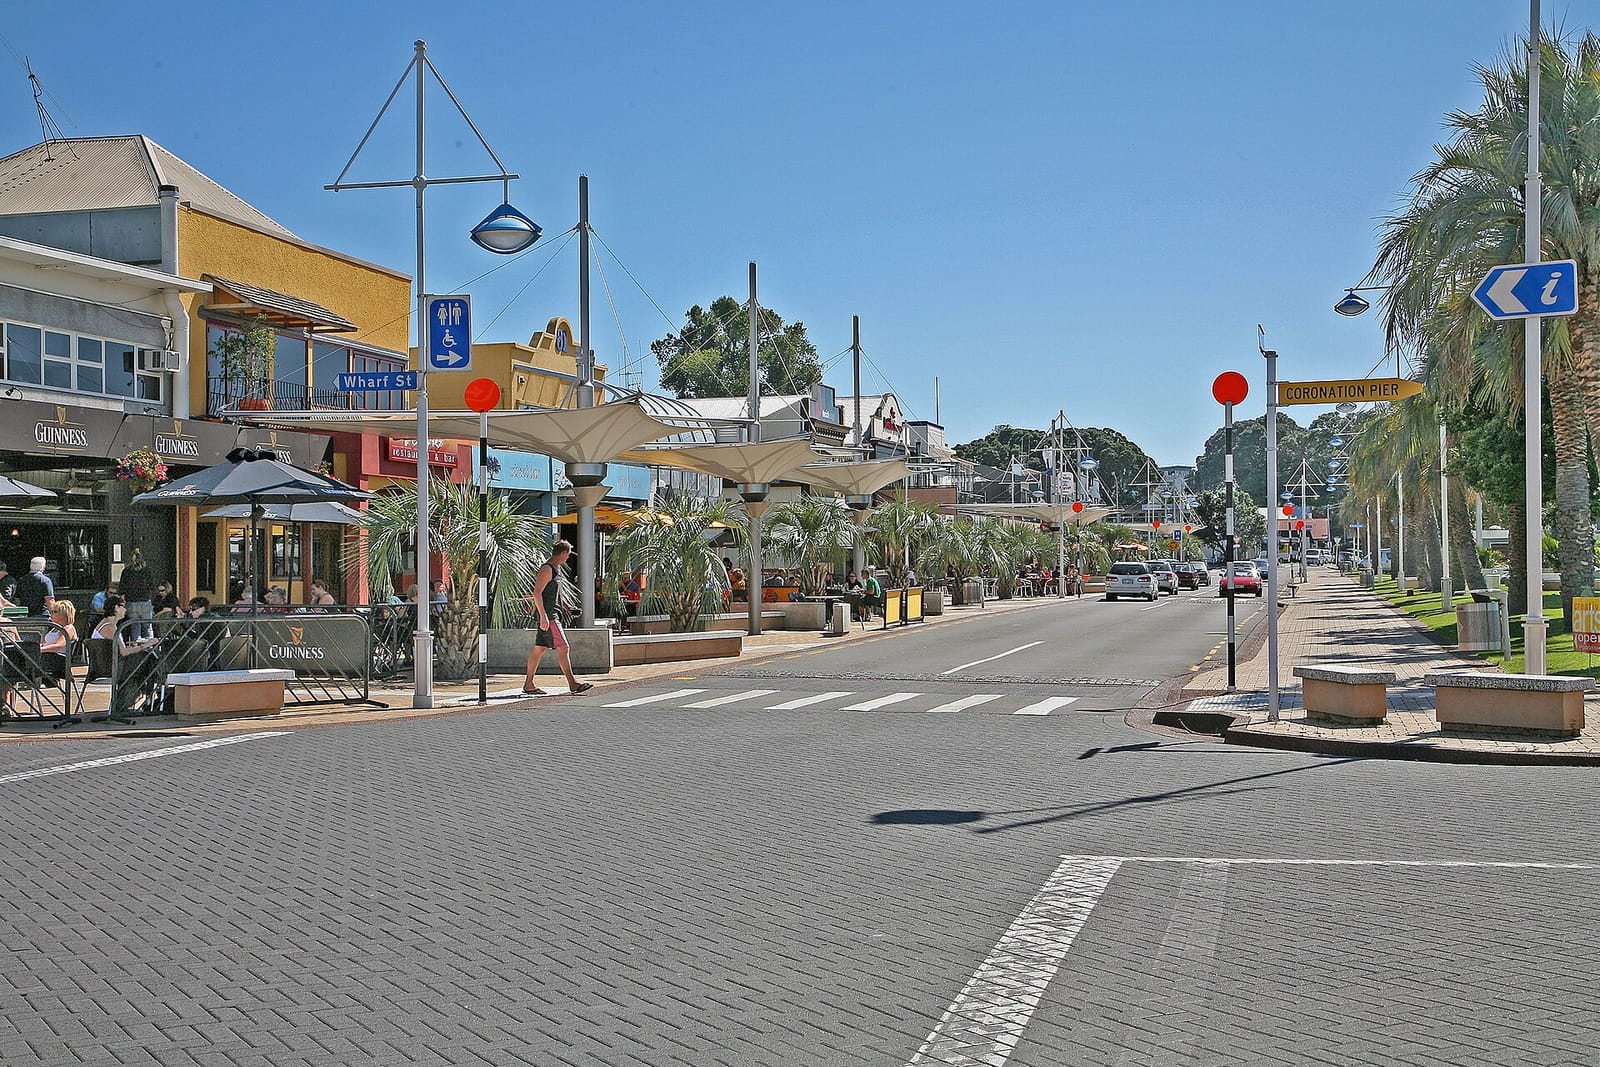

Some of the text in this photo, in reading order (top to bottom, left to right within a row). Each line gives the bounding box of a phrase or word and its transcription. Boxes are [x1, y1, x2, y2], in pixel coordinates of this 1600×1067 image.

[1540, 271, 1562, 305] i
[344, 374, 412, 388] Wharf St
[1286, 383, 1399, 400] CORONATION PIER
[34, 422, 88, 447] GUINNESS
[155, 434, 199, 457] GUINNESS
[444, 452, 455, 463] bar
[1577, 633, 1600, 645] ope
[269, 644, 324, 659] GUINNESS
